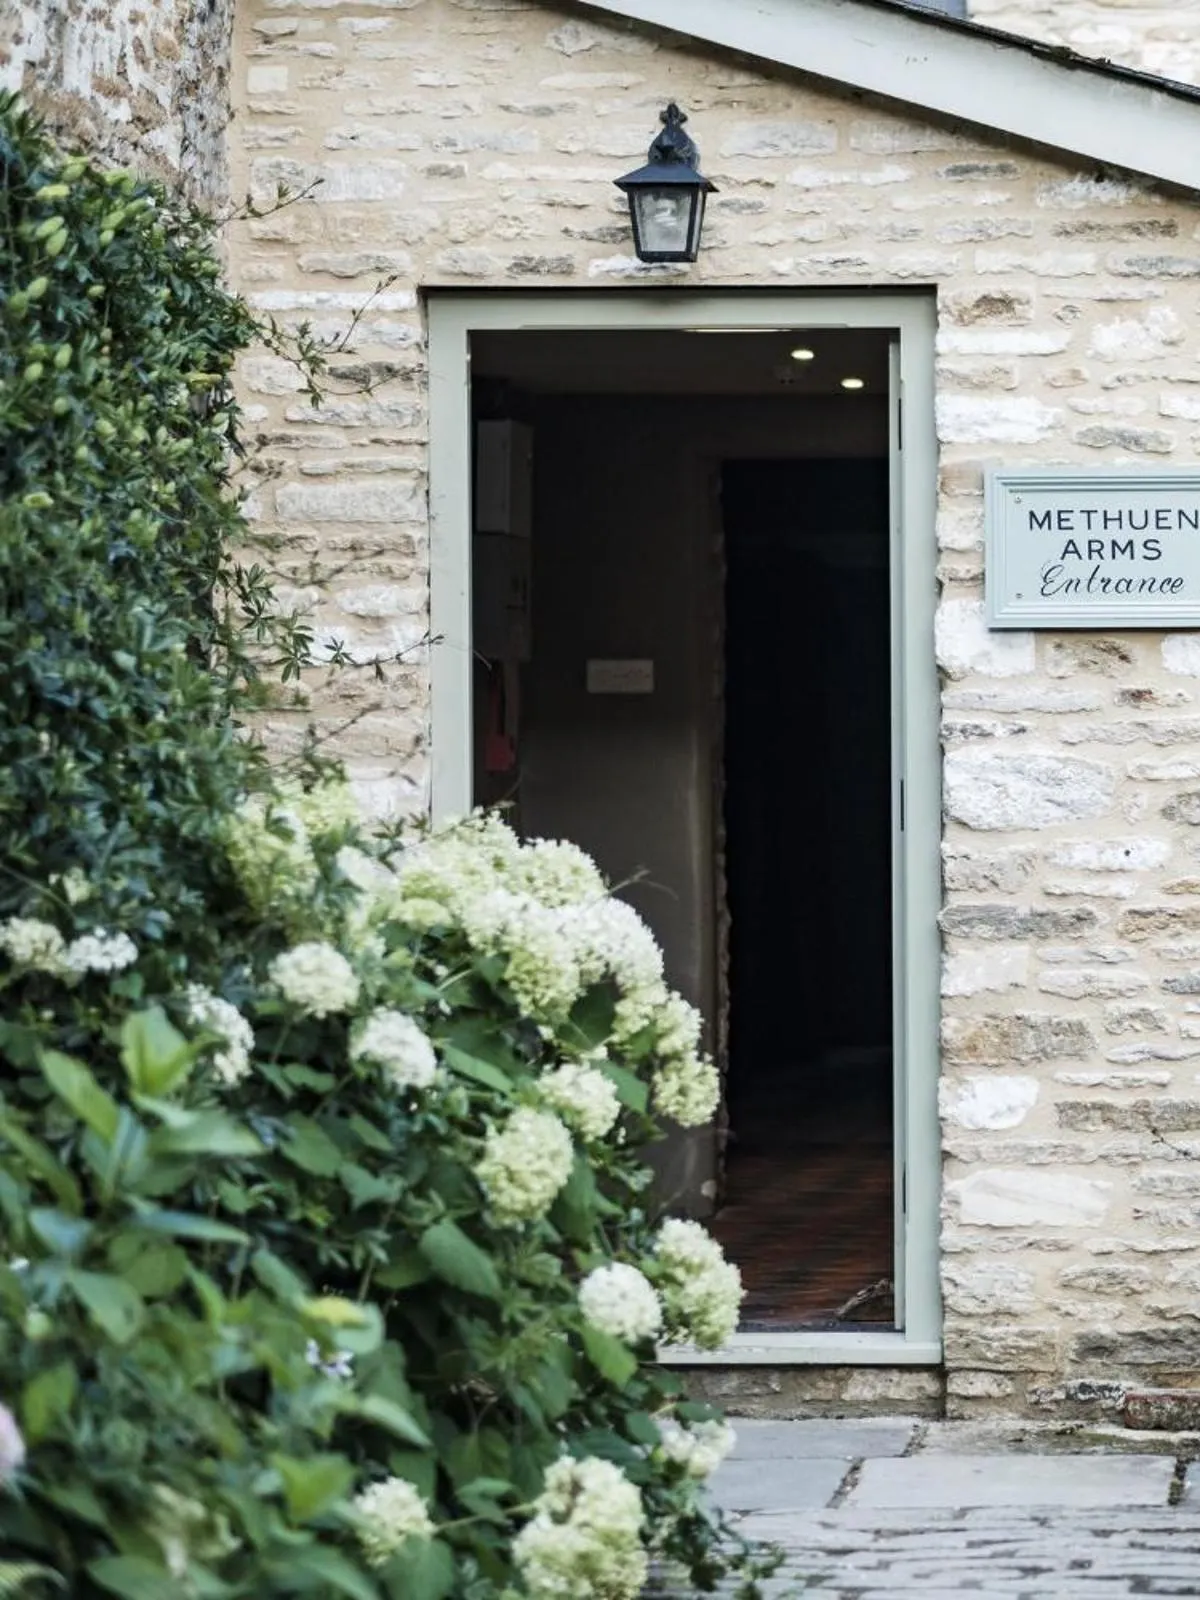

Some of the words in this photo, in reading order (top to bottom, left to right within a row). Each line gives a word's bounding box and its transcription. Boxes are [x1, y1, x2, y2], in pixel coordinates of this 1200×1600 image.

[1028, 509, 1199, 531] METHUEN
[1060, 538, 1163, 561] ARMS
[1039, 561, 1185, 598] Entrance
